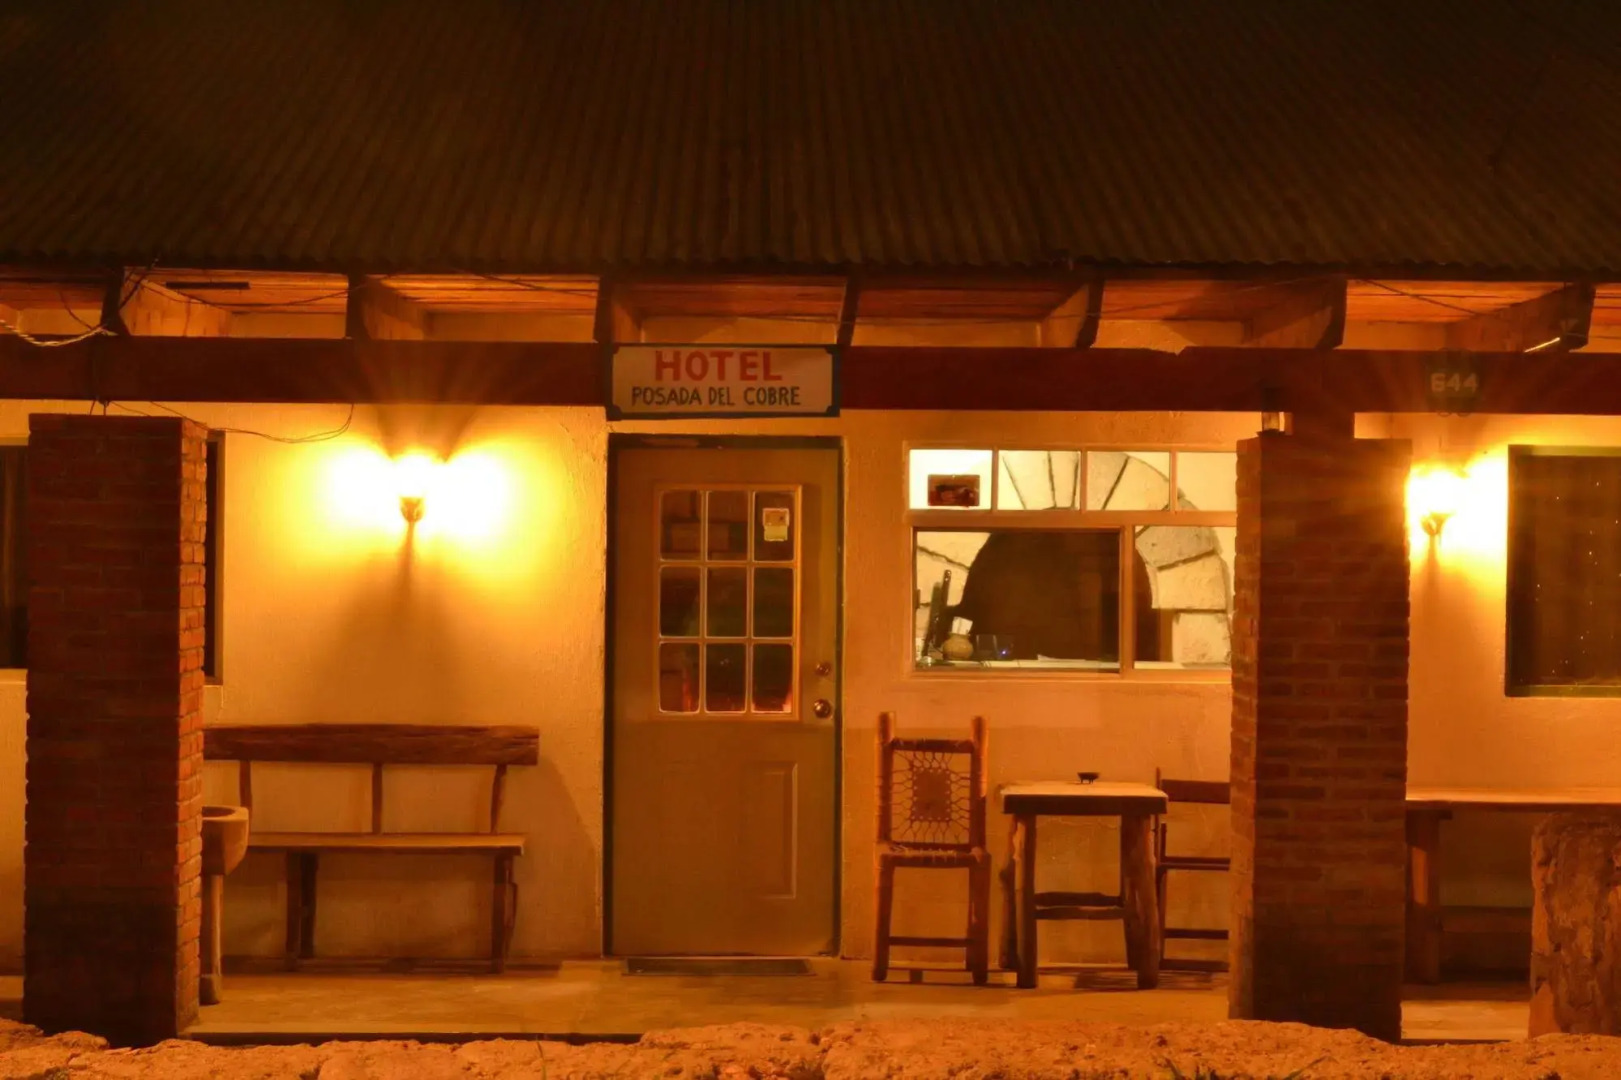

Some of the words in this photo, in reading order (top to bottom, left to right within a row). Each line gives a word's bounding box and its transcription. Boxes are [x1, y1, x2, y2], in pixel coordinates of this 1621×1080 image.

[655, 350, 782, 382] HOTEL
[1431, 372, 1479, 393] 644
[632, 386, 702, 406] POSADA
[708, 386, 735, 406] DEL
[744, 386, 801, 406] COBRE
